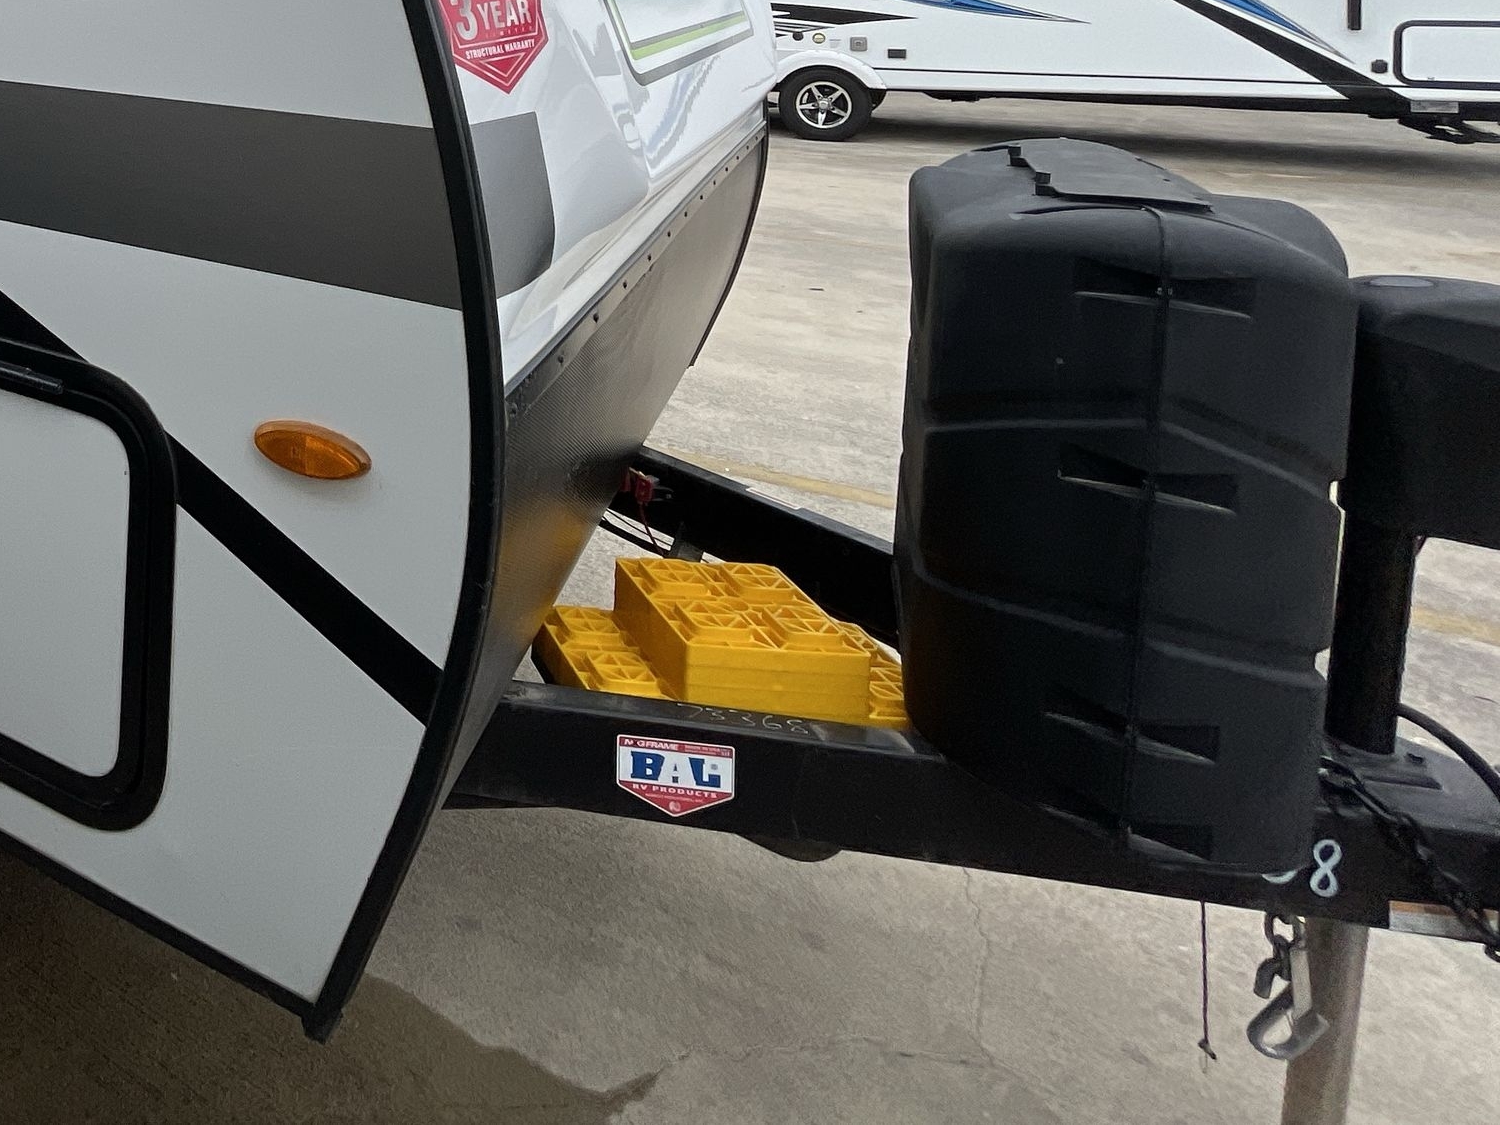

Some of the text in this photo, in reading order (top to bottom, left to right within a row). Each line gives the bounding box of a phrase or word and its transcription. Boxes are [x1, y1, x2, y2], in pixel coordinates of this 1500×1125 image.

[465, 38, 536, 60] STRUCTURAL WARRANTY
[630, 750, 722, 789] BAL
[632, 783, 649, 792] RV
[652, 784, 718, 799] PRODUCTS
